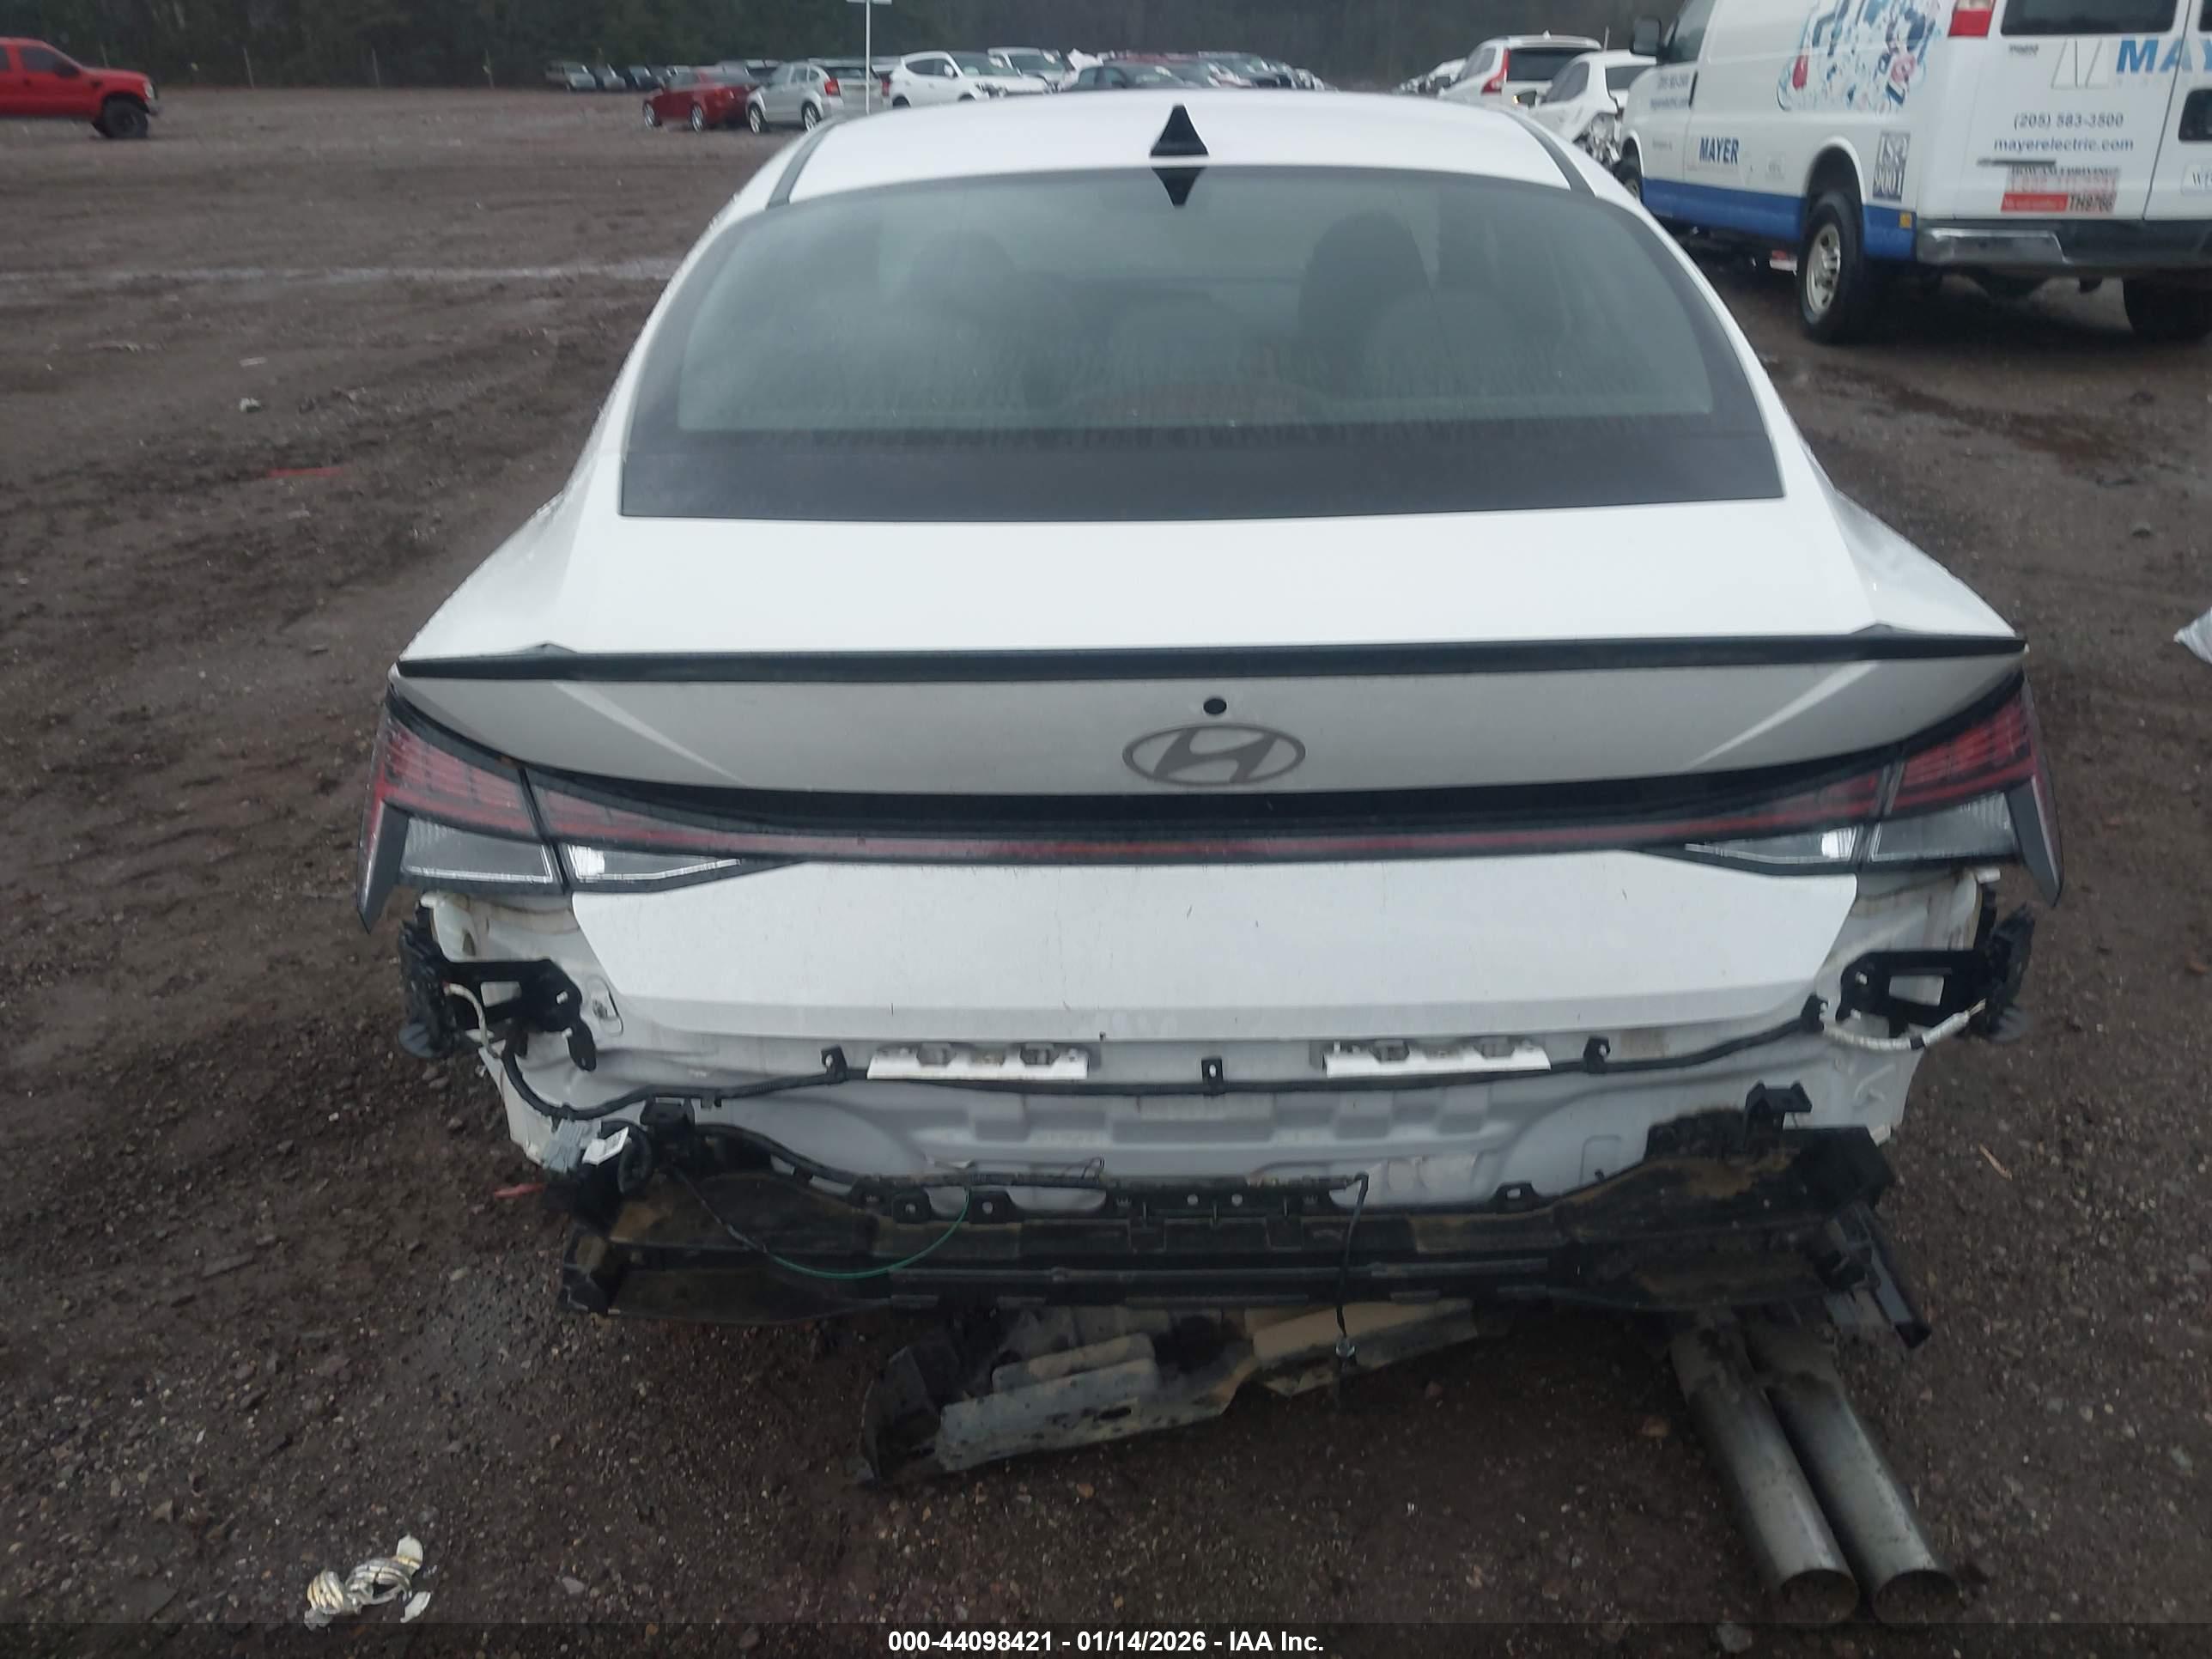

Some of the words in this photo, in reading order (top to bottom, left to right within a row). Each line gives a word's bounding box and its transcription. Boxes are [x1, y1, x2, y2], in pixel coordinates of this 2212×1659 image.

[2014, 112, 2051, 131] (205)
[2056, 111, 2124, 128] 583-3500
[1699, 137, 1740, 165] MAYER
[1994, 136, 2134, 155] mayerelectric.com
